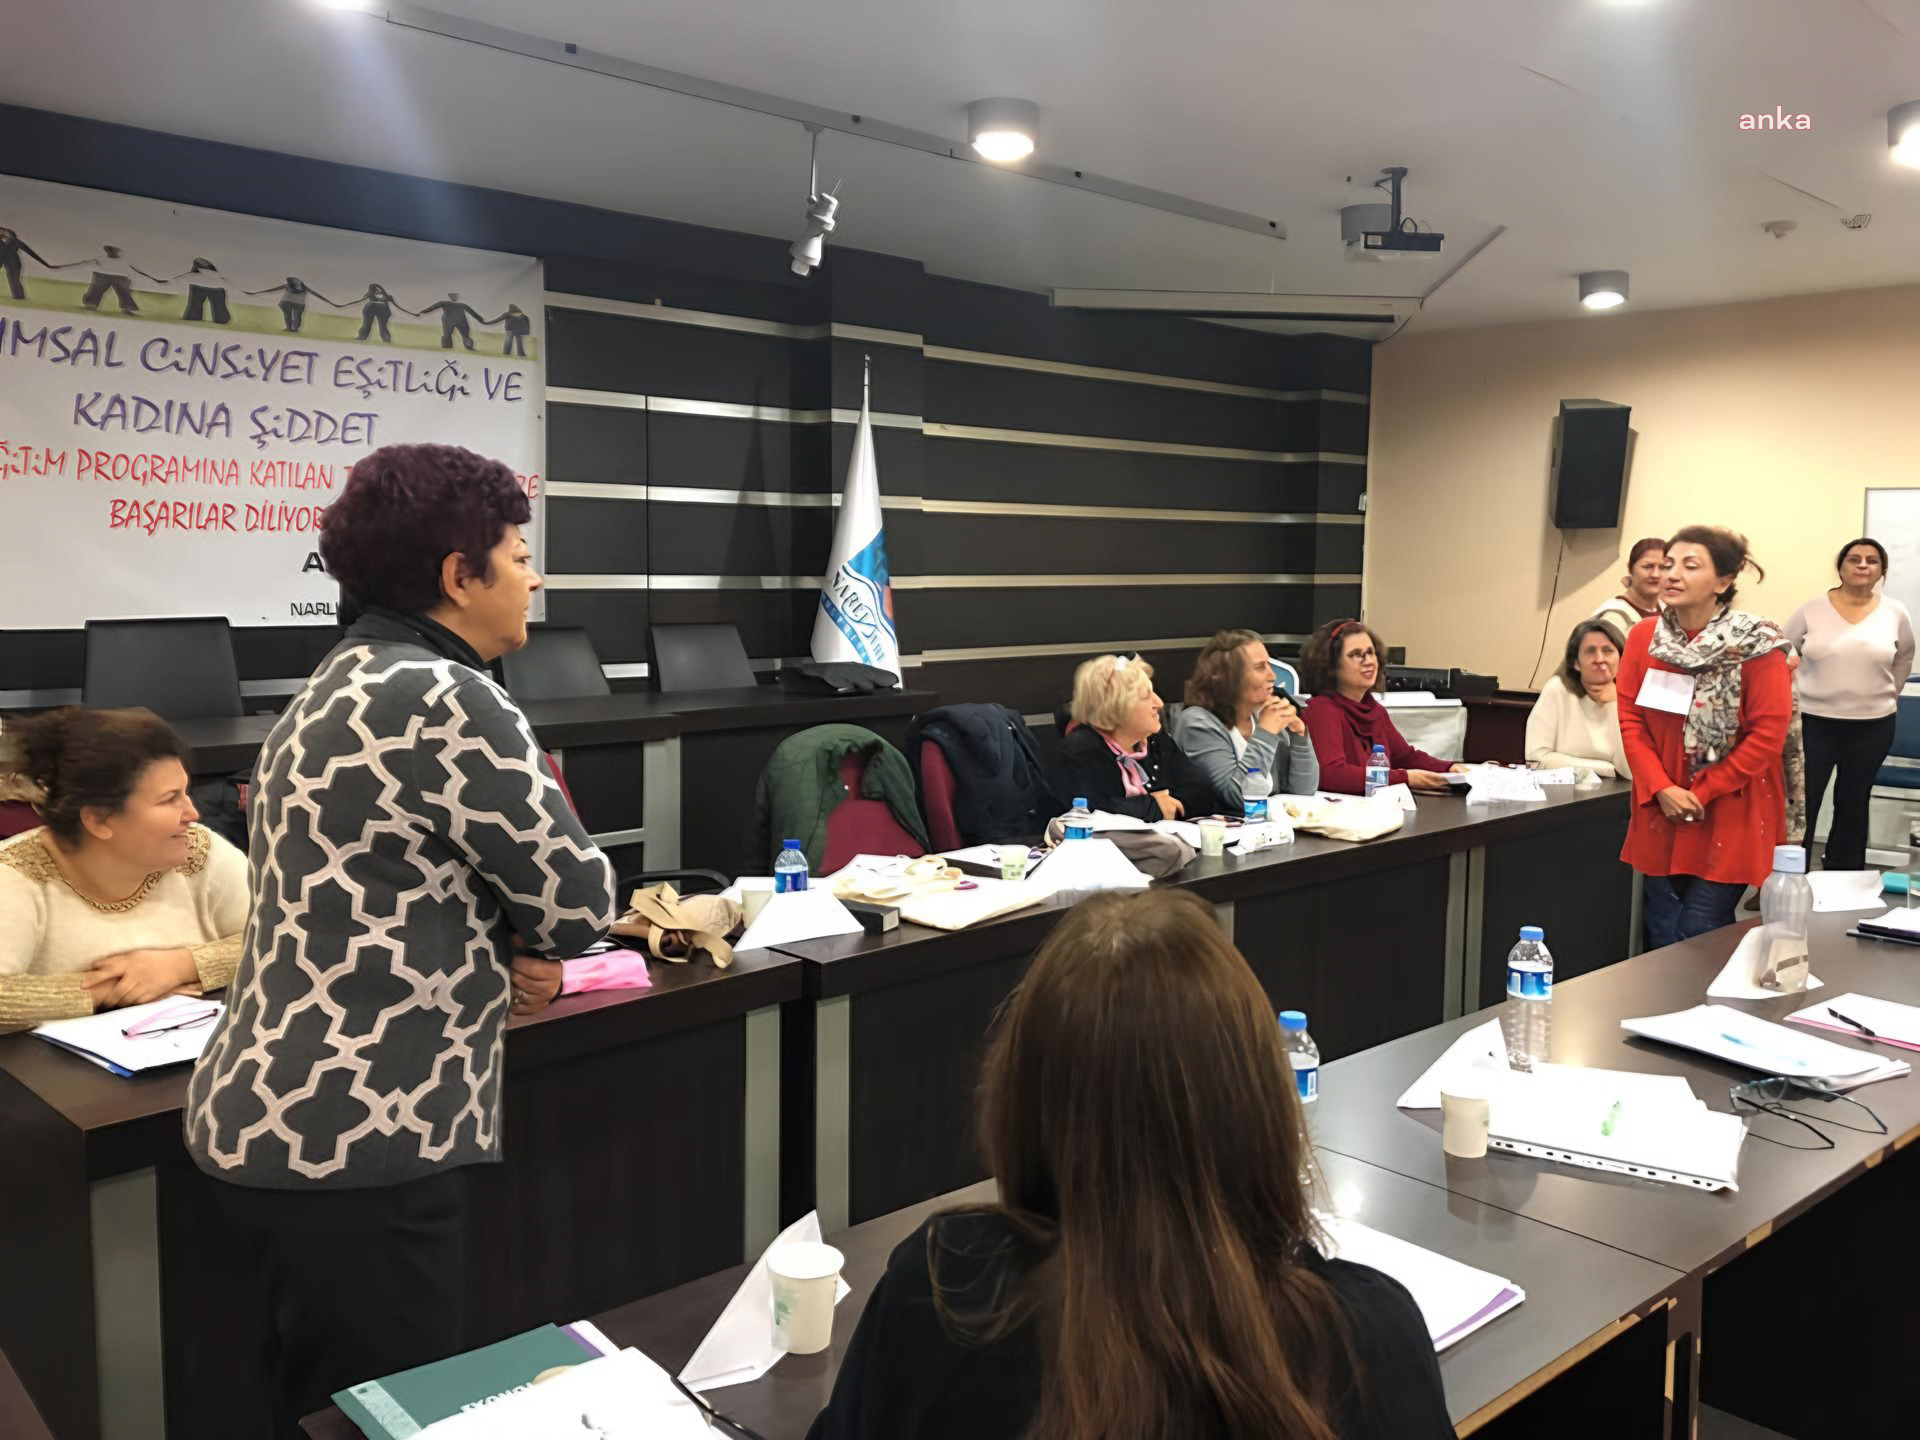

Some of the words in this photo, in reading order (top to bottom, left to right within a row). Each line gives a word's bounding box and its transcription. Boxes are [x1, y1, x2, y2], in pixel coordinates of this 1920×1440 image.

[484, 366, 523, 402] VE
[73, 391, 231, 438] KADINA
[76, 447, 240, 487] PROGRAMINA
[249, 458, 333, 490] KATILAN
[108, 498, 236, 536] BAŞARILAR
[244, 498, 324, 532] DİLİYOR
[290, 601, 339, 616] NARL
